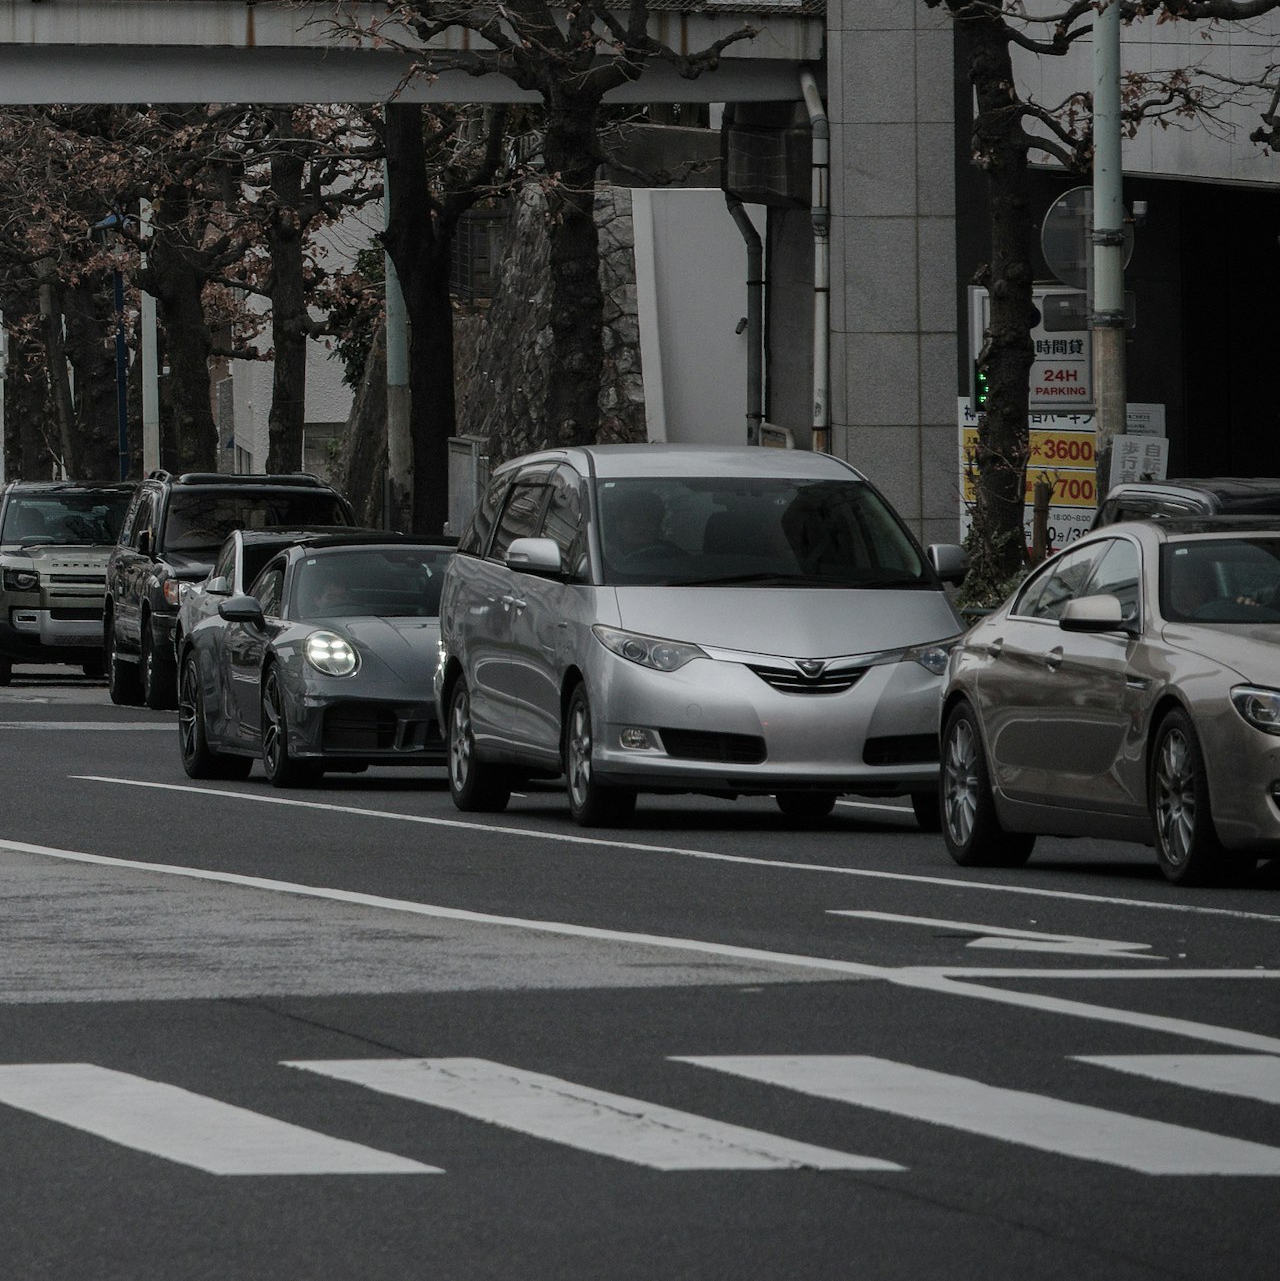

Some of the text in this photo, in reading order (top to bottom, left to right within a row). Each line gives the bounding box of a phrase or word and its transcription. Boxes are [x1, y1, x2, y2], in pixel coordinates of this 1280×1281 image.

[1035, 339, 1085, 355] 時間貸
[1043, 369, 1078, 382] 24H
[1035, 386, 1087, 396] PARKING
[1043, 438, 1096, 461] 3600
[1057, 478, 1096, 500] 700
